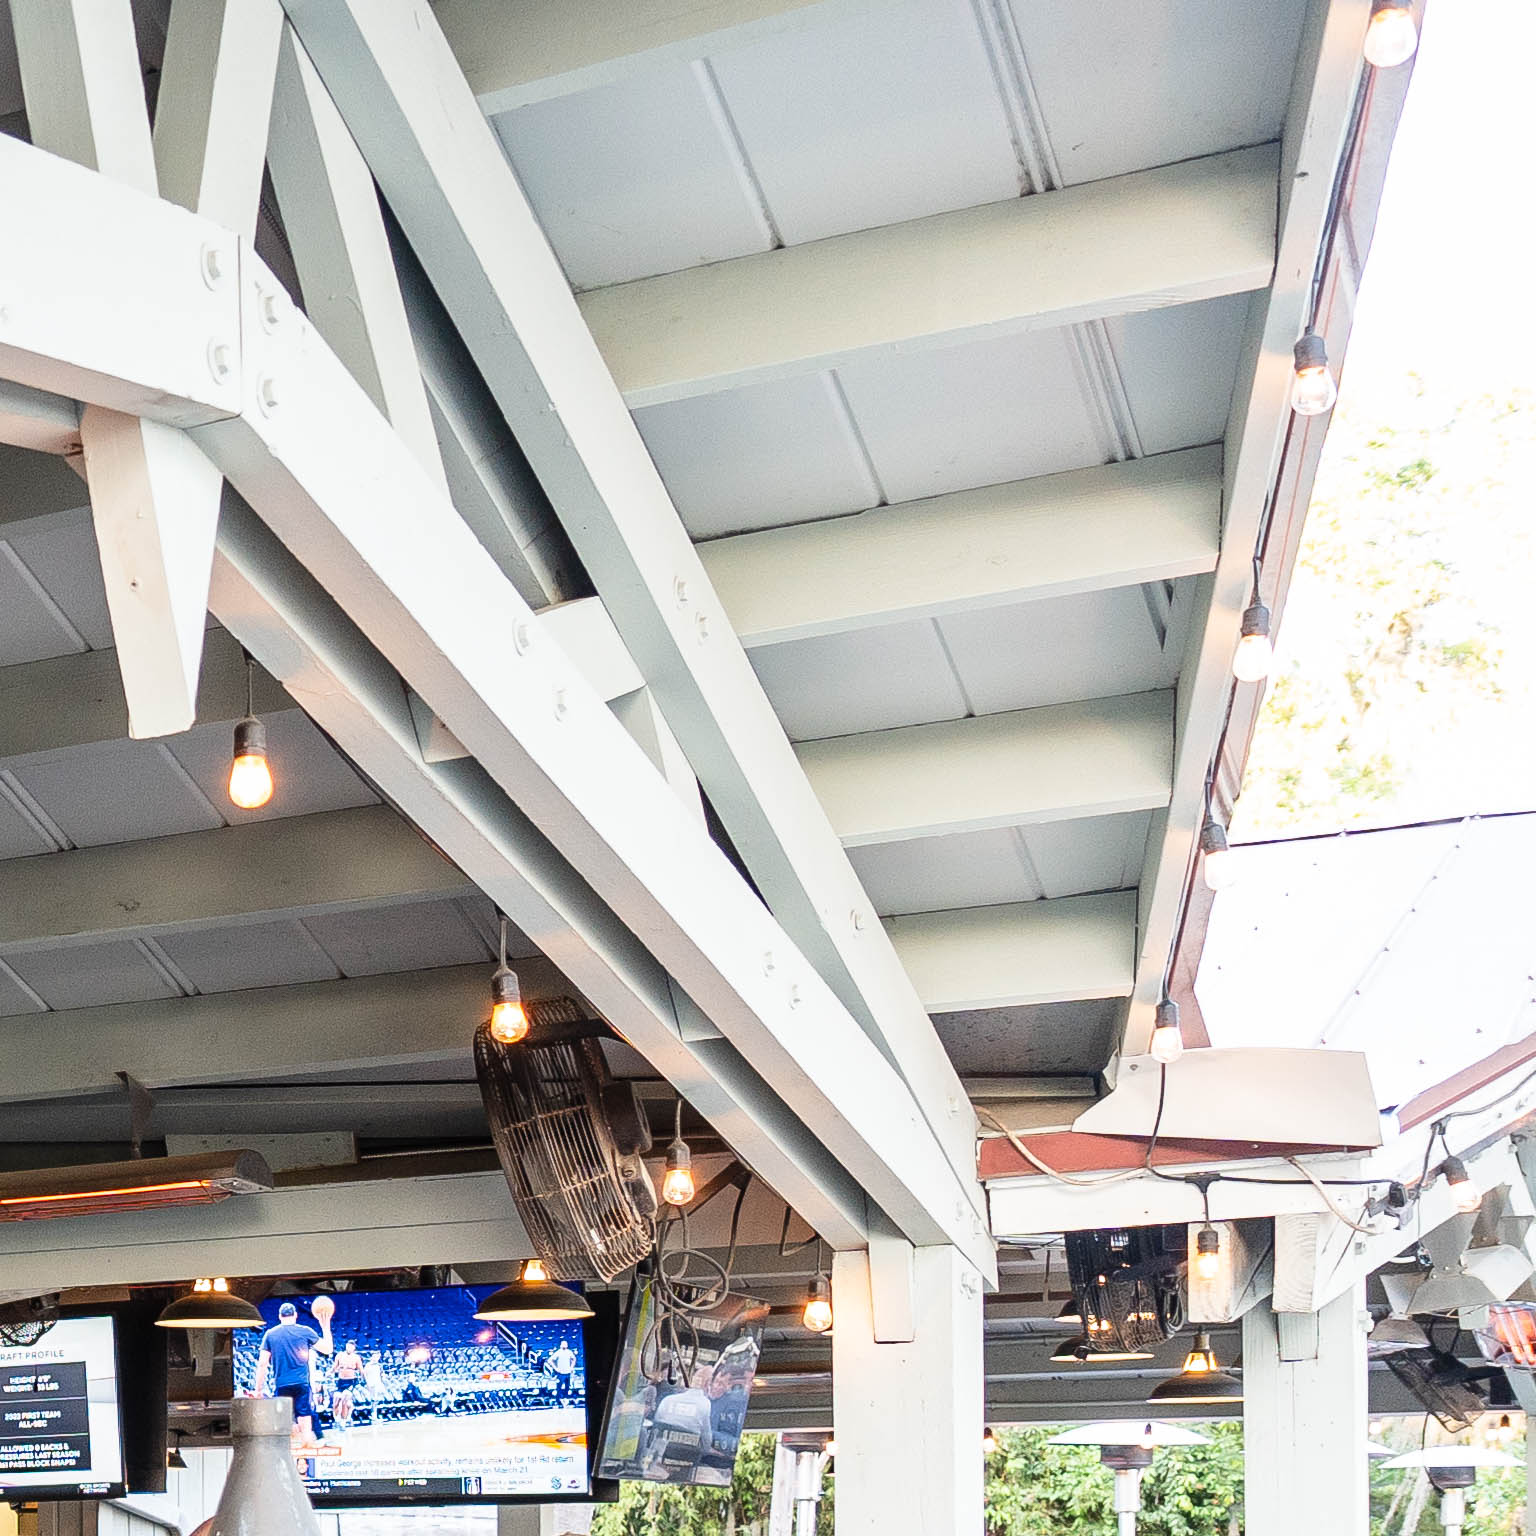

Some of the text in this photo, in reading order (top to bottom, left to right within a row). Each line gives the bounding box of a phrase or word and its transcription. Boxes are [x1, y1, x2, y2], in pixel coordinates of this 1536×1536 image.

[25, 1350, 64, 1359] PROFILE
[41, 1411, 61, 1419] TEAM
[0, 1445, 34, 1453] ALLOWED
[9, 1460, 26, 1468] PASS
